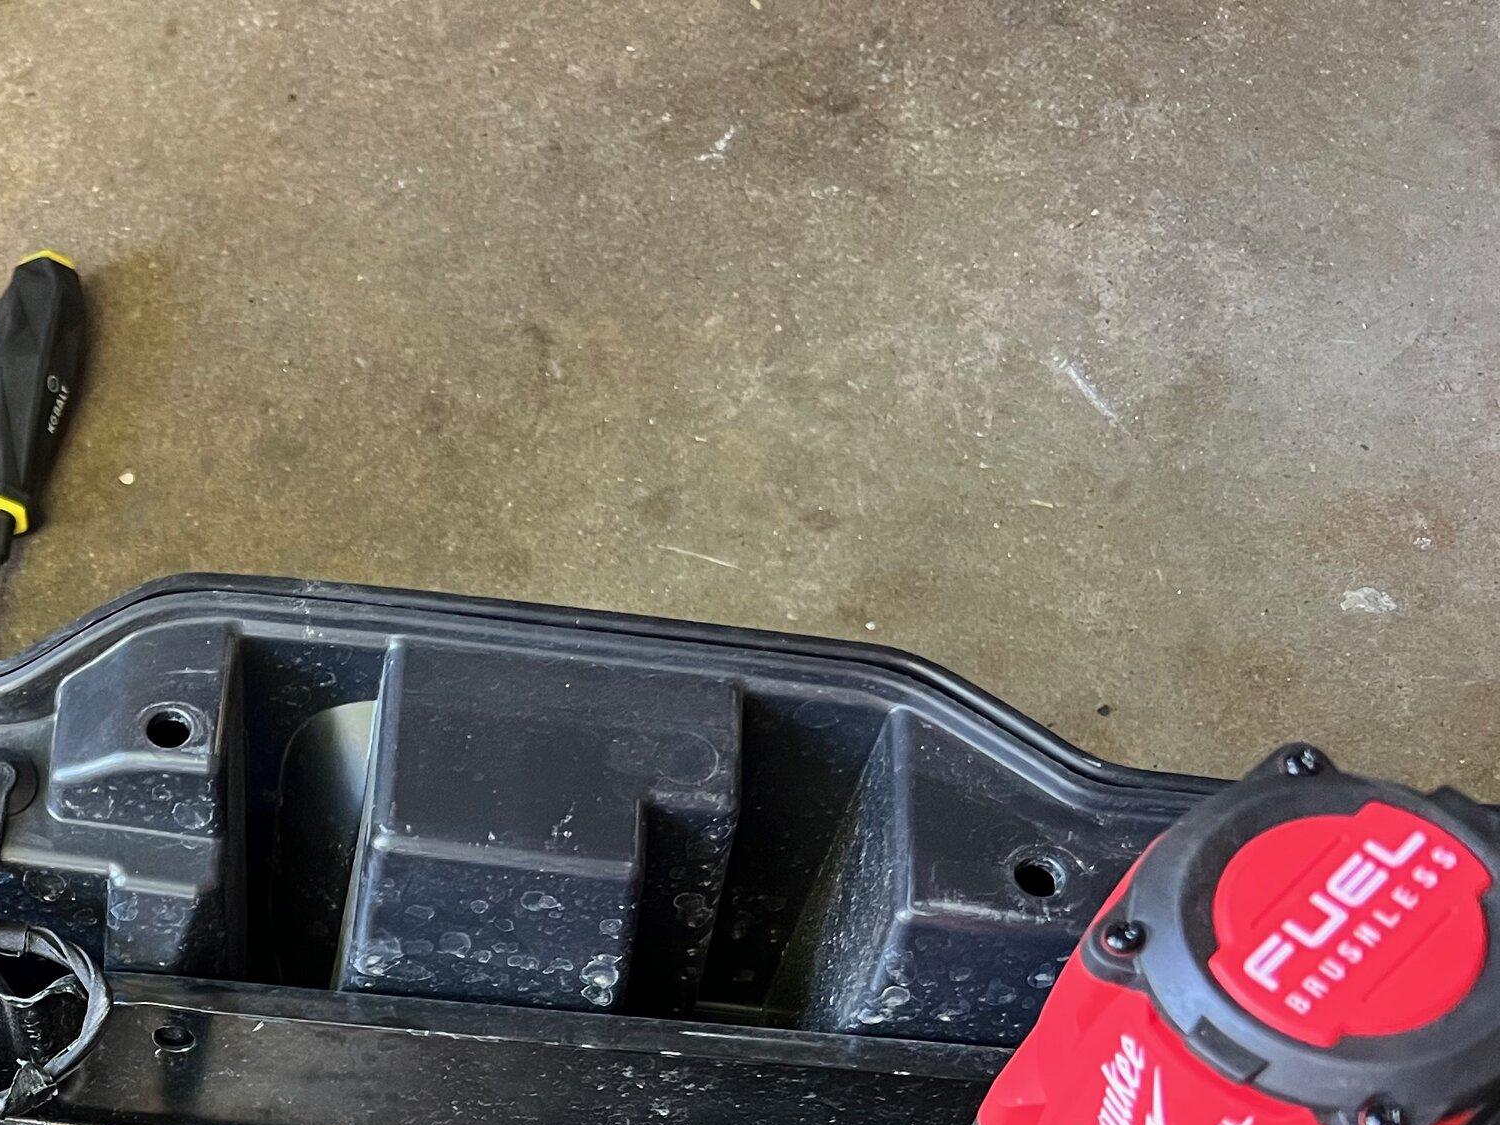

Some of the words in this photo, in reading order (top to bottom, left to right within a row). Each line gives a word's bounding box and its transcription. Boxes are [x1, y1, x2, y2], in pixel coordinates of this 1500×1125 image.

[47, 384, 70, 434] KOBALT
[1243, 830, 1428, 993] FUEL
[1284, 845, 1458, 1015] BRUSHLESS
